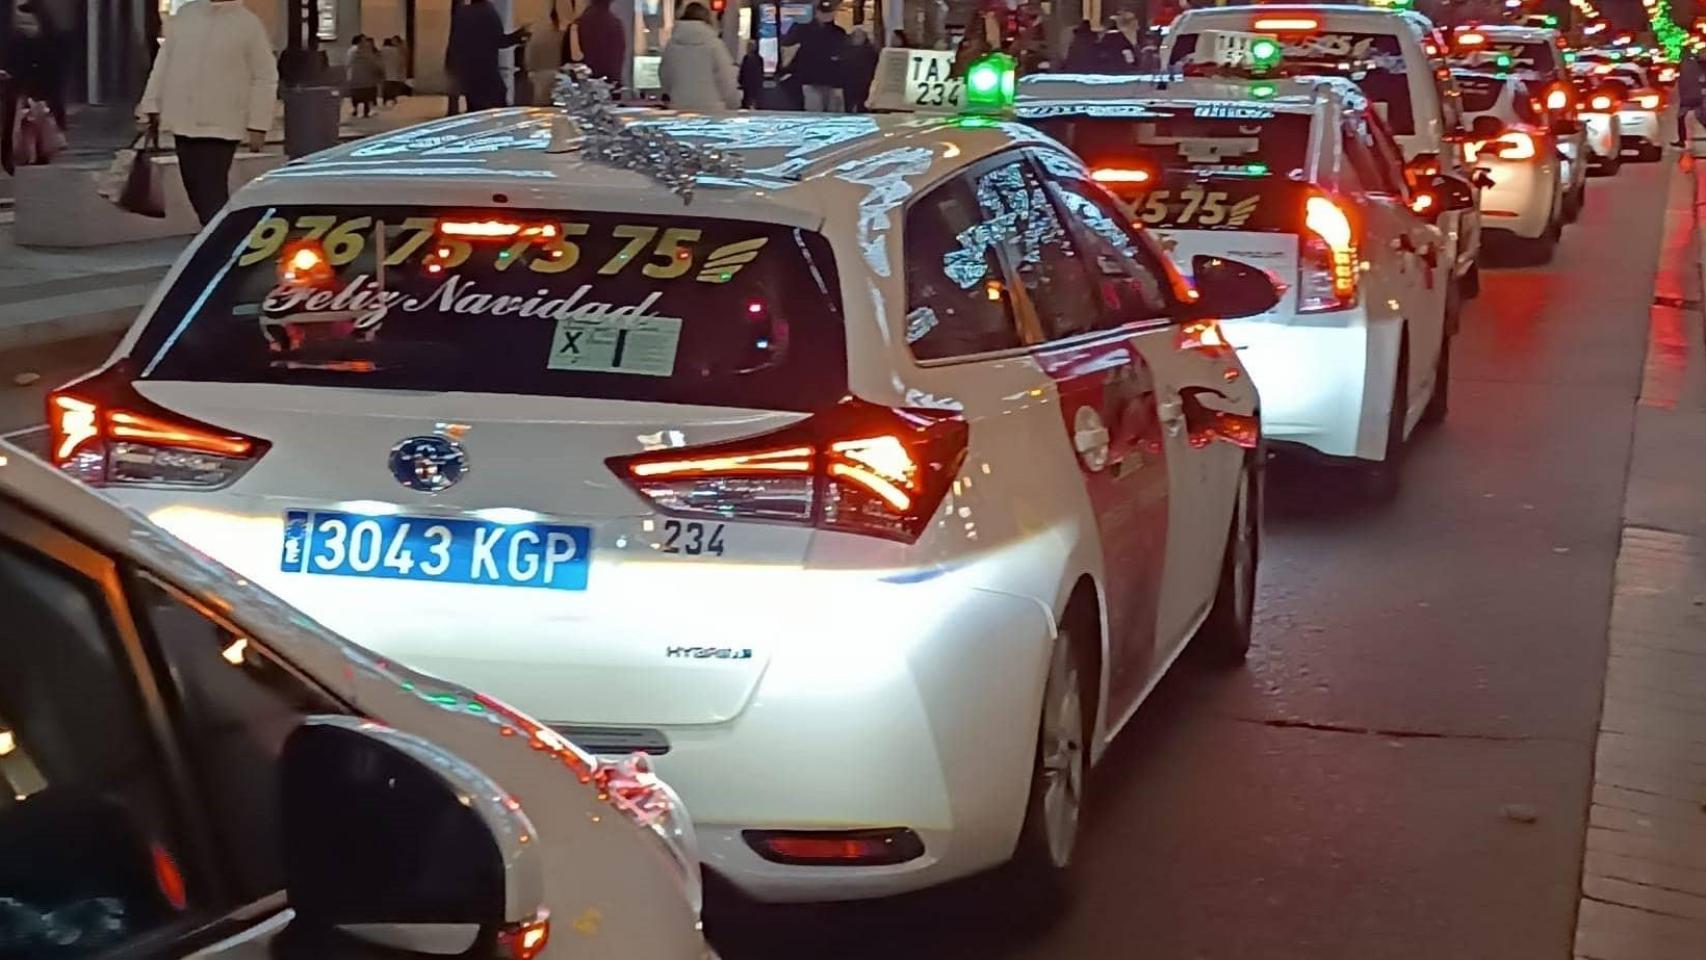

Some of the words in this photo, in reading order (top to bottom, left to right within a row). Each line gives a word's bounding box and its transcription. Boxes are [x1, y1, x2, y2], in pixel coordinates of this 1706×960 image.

[916, 82, 960, 106] 234
[1177, 190, 1227, 225] 75
[238, 215, 372, 267] 976
[383, 216, 473, 268] 75
[495, 223, 590, 273] 75
[598, 224, 702, 279] 75
[262, 274, 404, 329] Feliz
[403, 274, 663, 323] Navidad
[314, 519, 453, 576] 3043
[470, 527, 578, 584] KGP
[663, 519, 725, 557] 234
